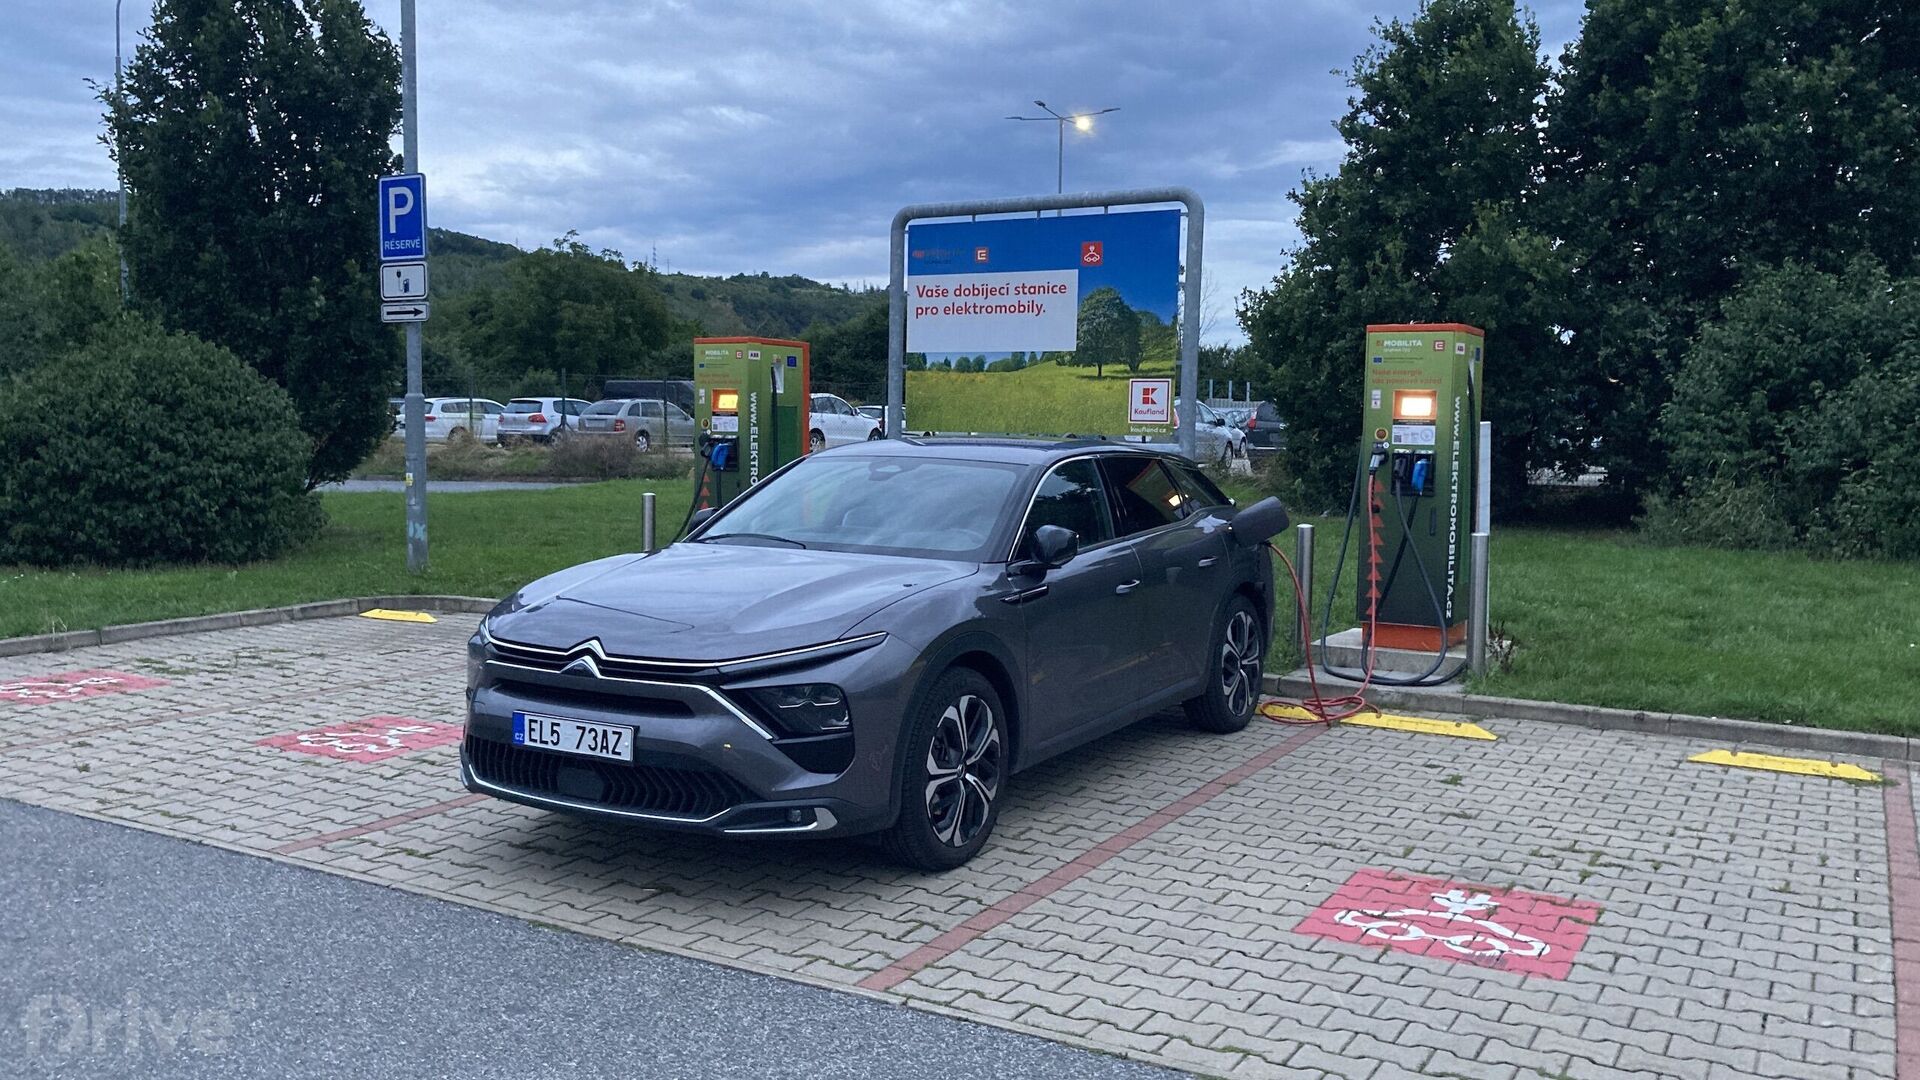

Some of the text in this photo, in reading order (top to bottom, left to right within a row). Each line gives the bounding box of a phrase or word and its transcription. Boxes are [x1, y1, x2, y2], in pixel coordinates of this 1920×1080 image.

[388, 186, 414, 234] P
[384, 238, 421, 250] RÉSERVÉ
[916, 281, 1067, 300] Vaše dobíjecí stanice
[915, 300, 1046, 319] pro elektromobily.
[514, 732, 524, 741] CZ
[528, 718, 623, 756] EL5 73AZ
